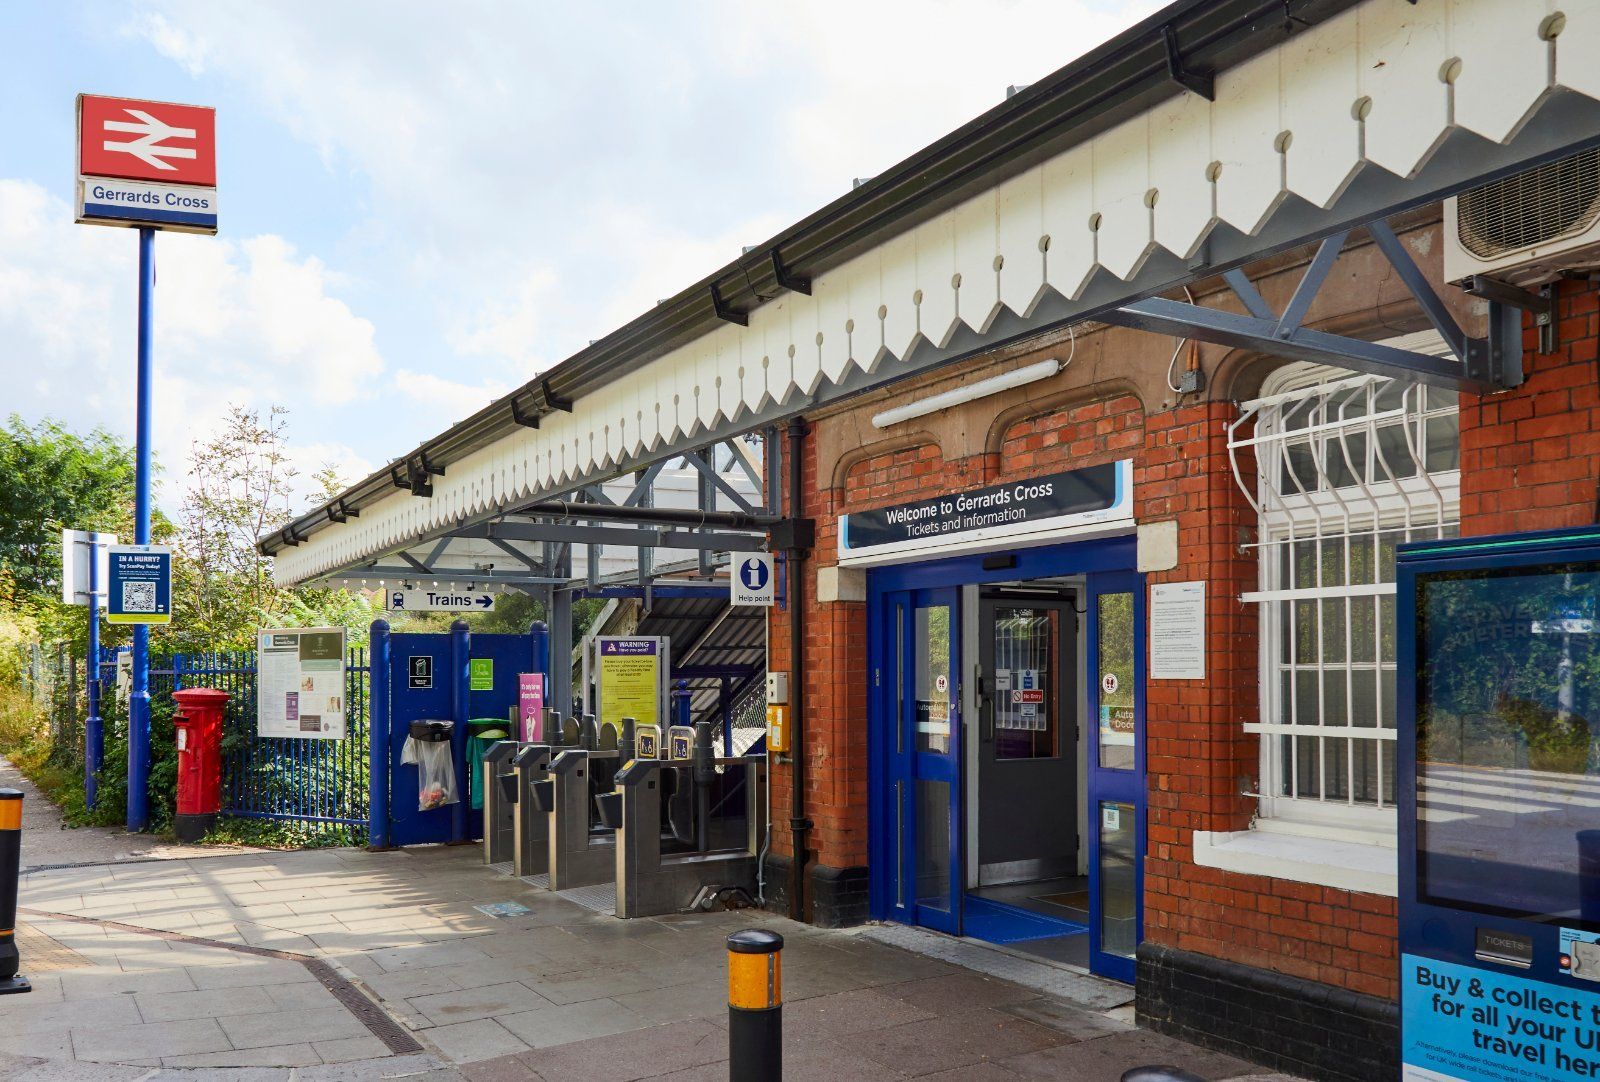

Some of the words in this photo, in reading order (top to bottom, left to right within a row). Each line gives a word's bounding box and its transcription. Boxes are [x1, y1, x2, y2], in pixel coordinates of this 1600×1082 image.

[93, 186, 160, 204] Gerrards
[165, 193, 209, 209] Cross
[886, 505, 937, 525] Welcome
[940, 502, 953, 514] to
[957, 488, 1011, 513] Gerrards
[1014, 482, 1053, 502] Cross
[906, 518, 939, 537] Tickets
[941, 514, 961, 530] and
[964, 506, 1026, 528] information
[427, 592, 472, 606] Trains
[738, 594, 754, 603] Help
[754, 594, 771, 603] point
[1485, 935, 1524, 951] TICKETS
[1416, 965, 1460, 996] Buy
[1468, 977, 1485, 999] &
[1491, 987, 1582, 1021] collect
[1432, 993, 1465, 1018] for
[1471, 1005, 1498, 1027] all
[1506, 1014, 1566, 1043] your
[1574, 1026, 1600, 1053] U
[1415, 1040, 1457, 1058] Alternatively,
[1458, 1052, 1481, 1064] please
[1482, 1058, 1519, 1073] download
[1519, 1069, 1533, 1077] our
[1472, 1028, 1546, 1065] travel
[1425, 1052, 1435, 1061] for
[1436, 1056, 1448, 1064] UK
[1448, 1060, 1466, 1070] wide
[1478, 1068, 1502, 1080] tickets
